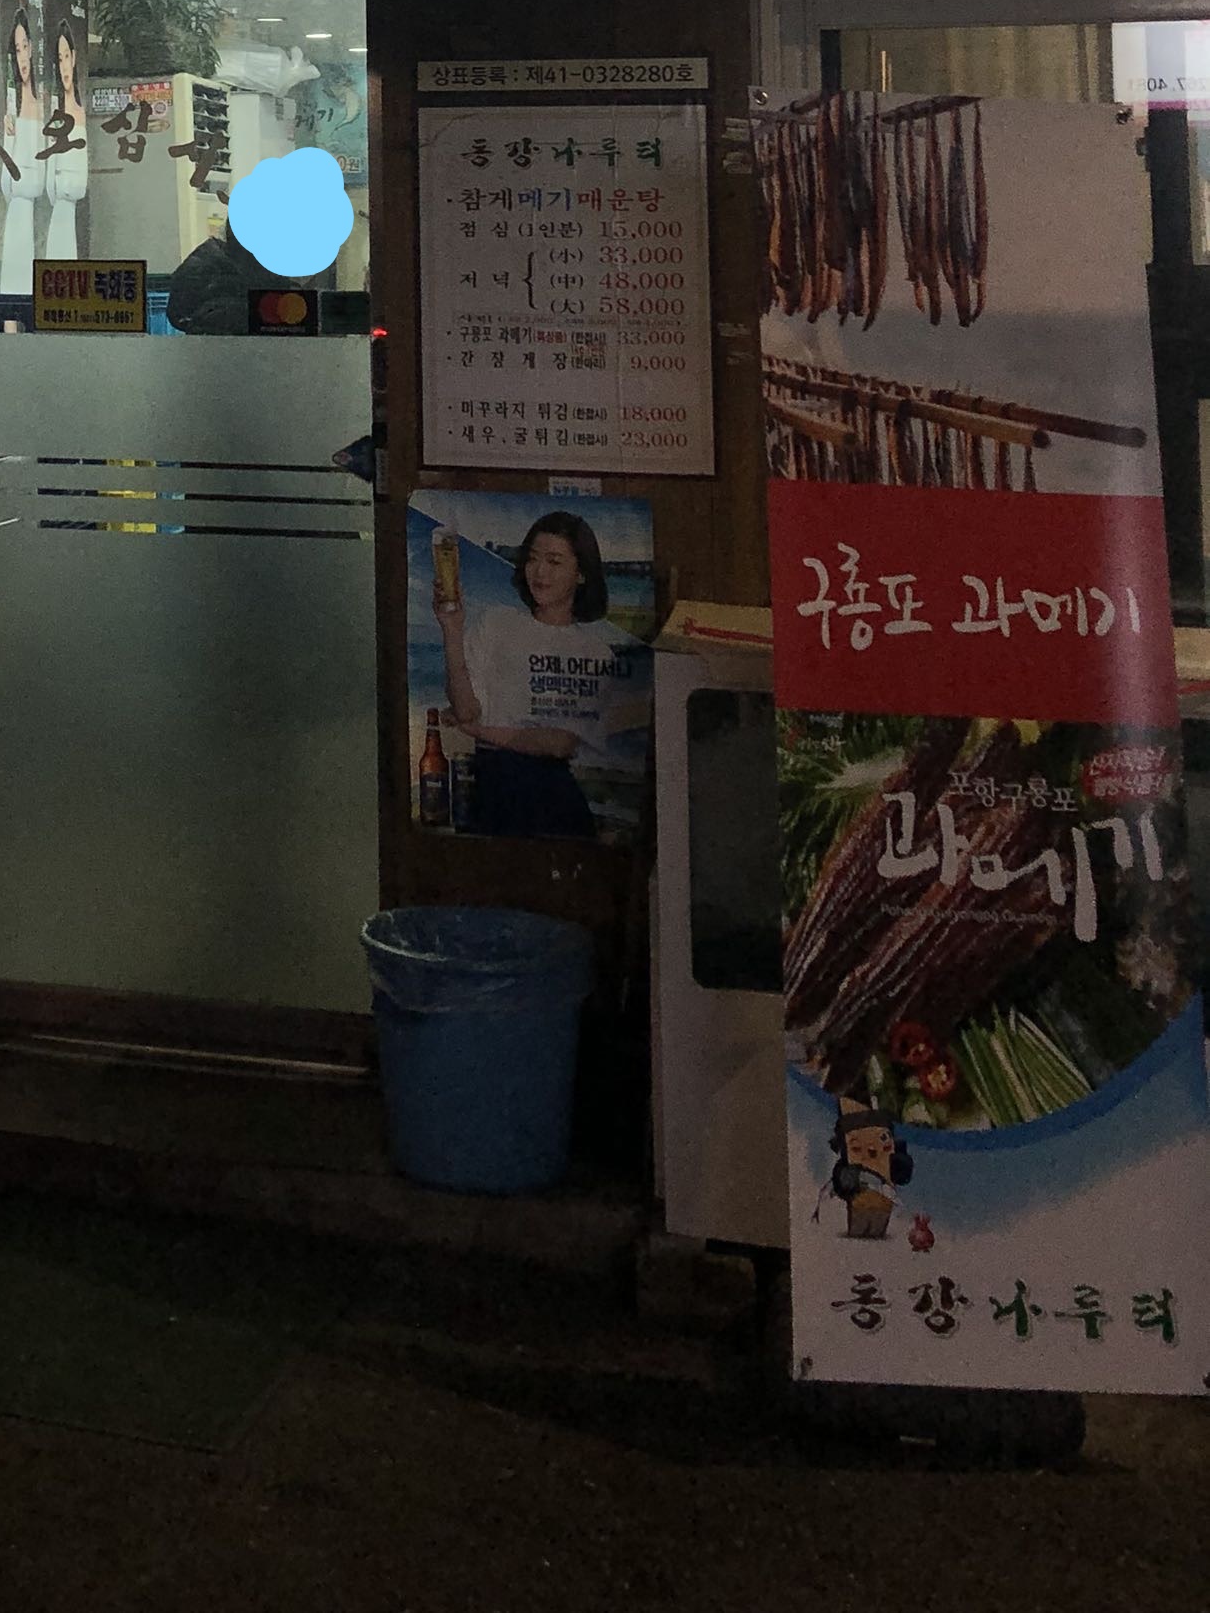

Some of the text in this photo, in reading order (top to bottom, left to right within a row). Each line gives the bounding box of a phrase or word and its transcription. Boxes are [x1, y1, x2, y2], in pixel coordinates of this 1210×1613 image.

[431, 65, 508, 86] 상표등록
[525, 64, 695, 85] 제41-0328280호
[600, 221, 683, 240] 15,000
[599, 246, 683, 266] 33,000
[599, 271, 684, 291] 48,000
[599, 297, 685, 317] 58,000
[630, 355, 686, 371] 9,000
[620, 406, 687, 422] 18,000
[620, 431, 688, 449] 23,000
[796, 542, 1141, 650] 구룡포 과메기
[876, 789, 1163, 942] 과메기
